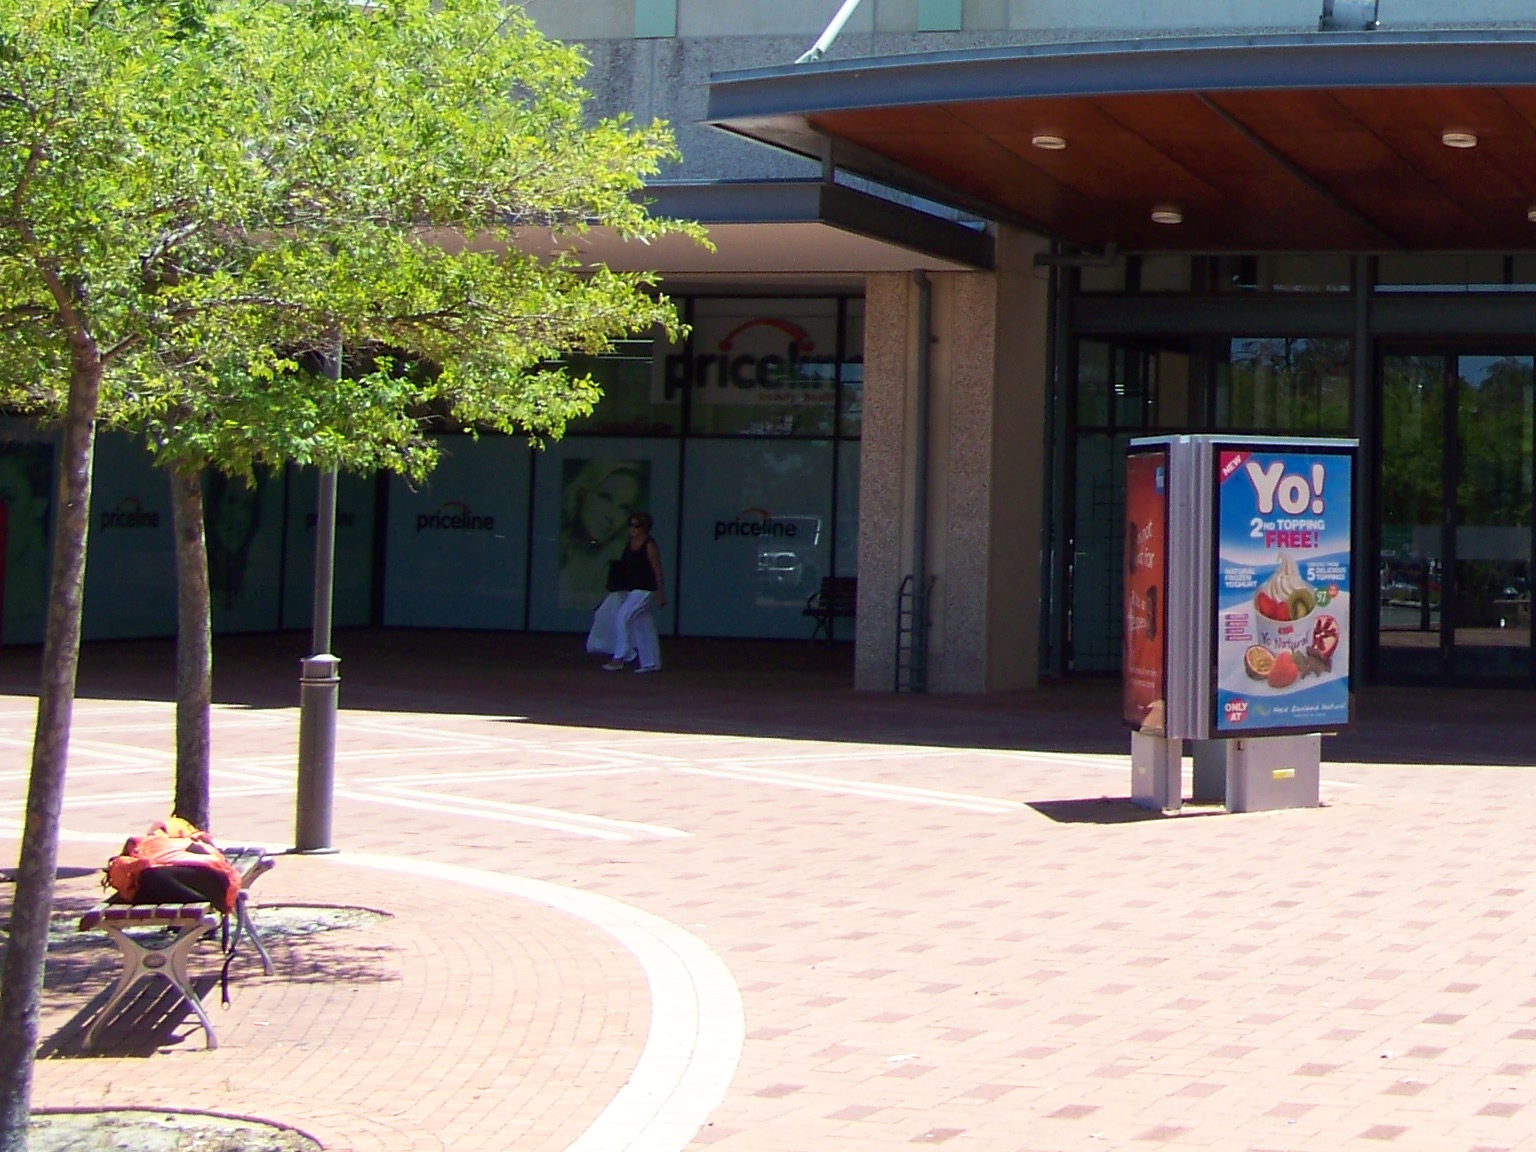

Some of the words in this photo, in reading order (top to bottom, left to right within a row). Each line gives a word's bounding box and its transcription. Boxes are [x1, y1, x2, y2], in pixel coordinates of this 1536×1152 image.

[1221, 454, 1243, 477] NEW
[1246, 462, 1325, 515] Yo!
[100, 507, 161, 533] priceline
[415, 509, 495, 532] priceline
[714, 518, 798, 541] priceline
[1276, 519, 1326, 531] TOPPING
[1265, 530, 1320, 549] FREE!
[1306, 567, 1316, 582] 5
[1225, 581, 1258, 589] YOGHURT
[1225, 702, 1248, 713] ONLY
[1230, 712, 1242, 722] AT
